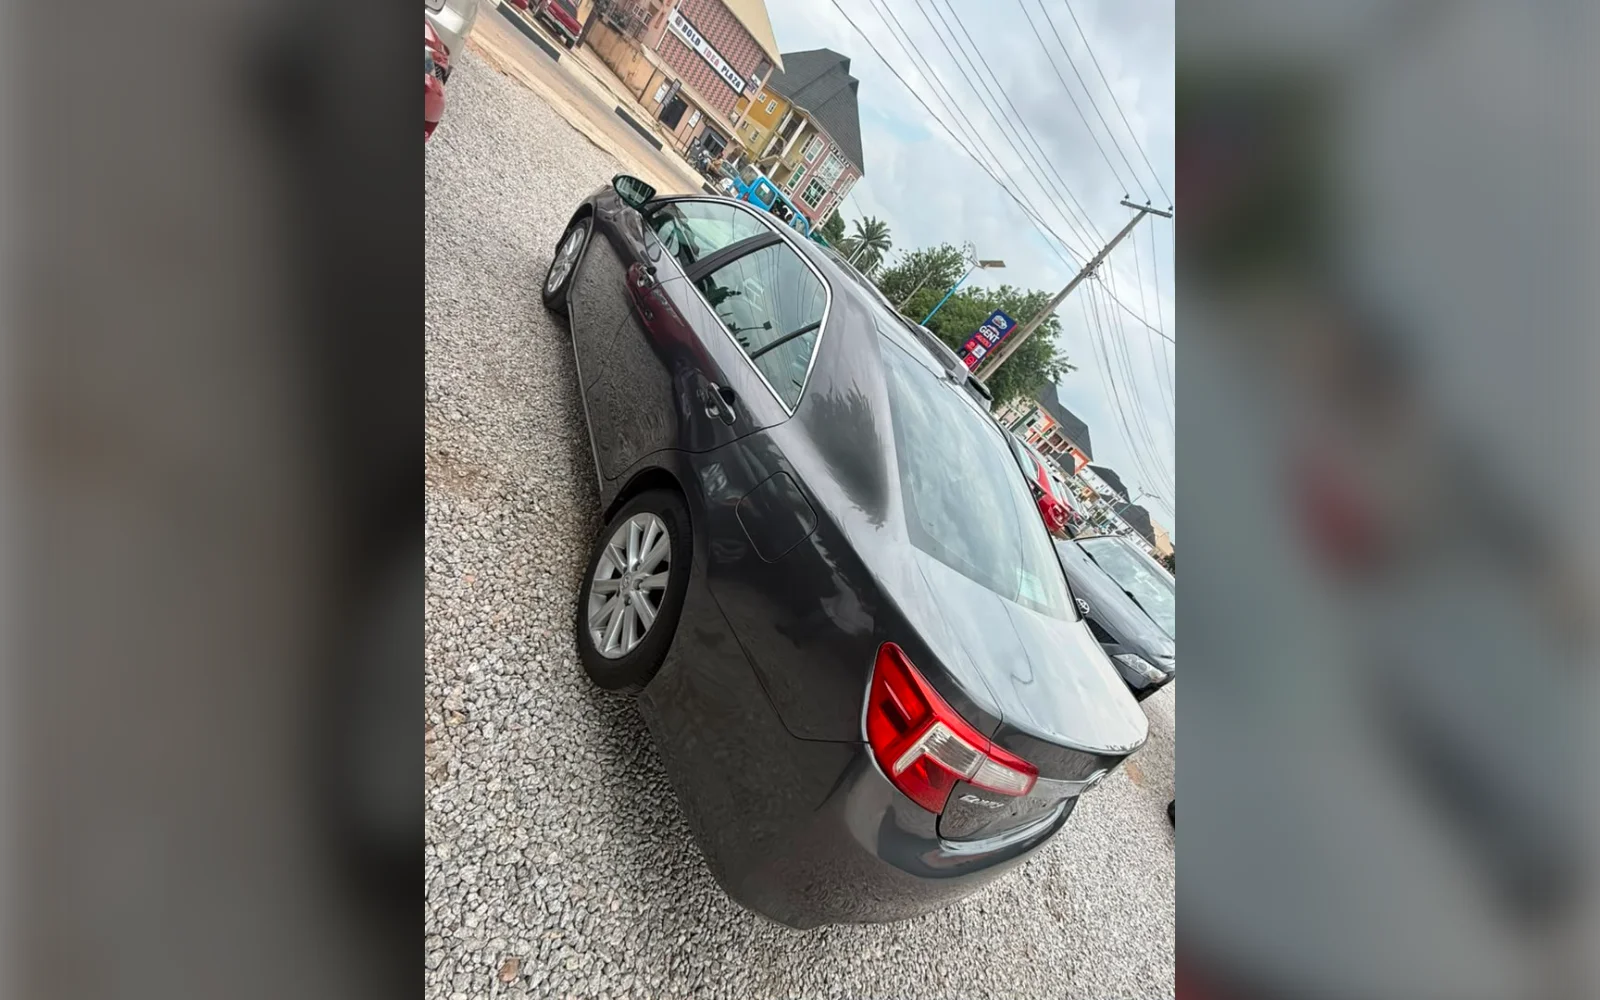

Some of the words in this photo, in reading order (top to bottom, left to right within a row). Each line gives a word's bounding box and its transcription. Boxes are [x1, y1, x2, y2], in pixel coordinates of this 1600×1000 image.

[681, 24, 701, 46] BOLD
[703, 47, 720, 67] IDEA
[721, 65, 741, 89] PLAZA
[979, 325, 1000, 343] GENT
